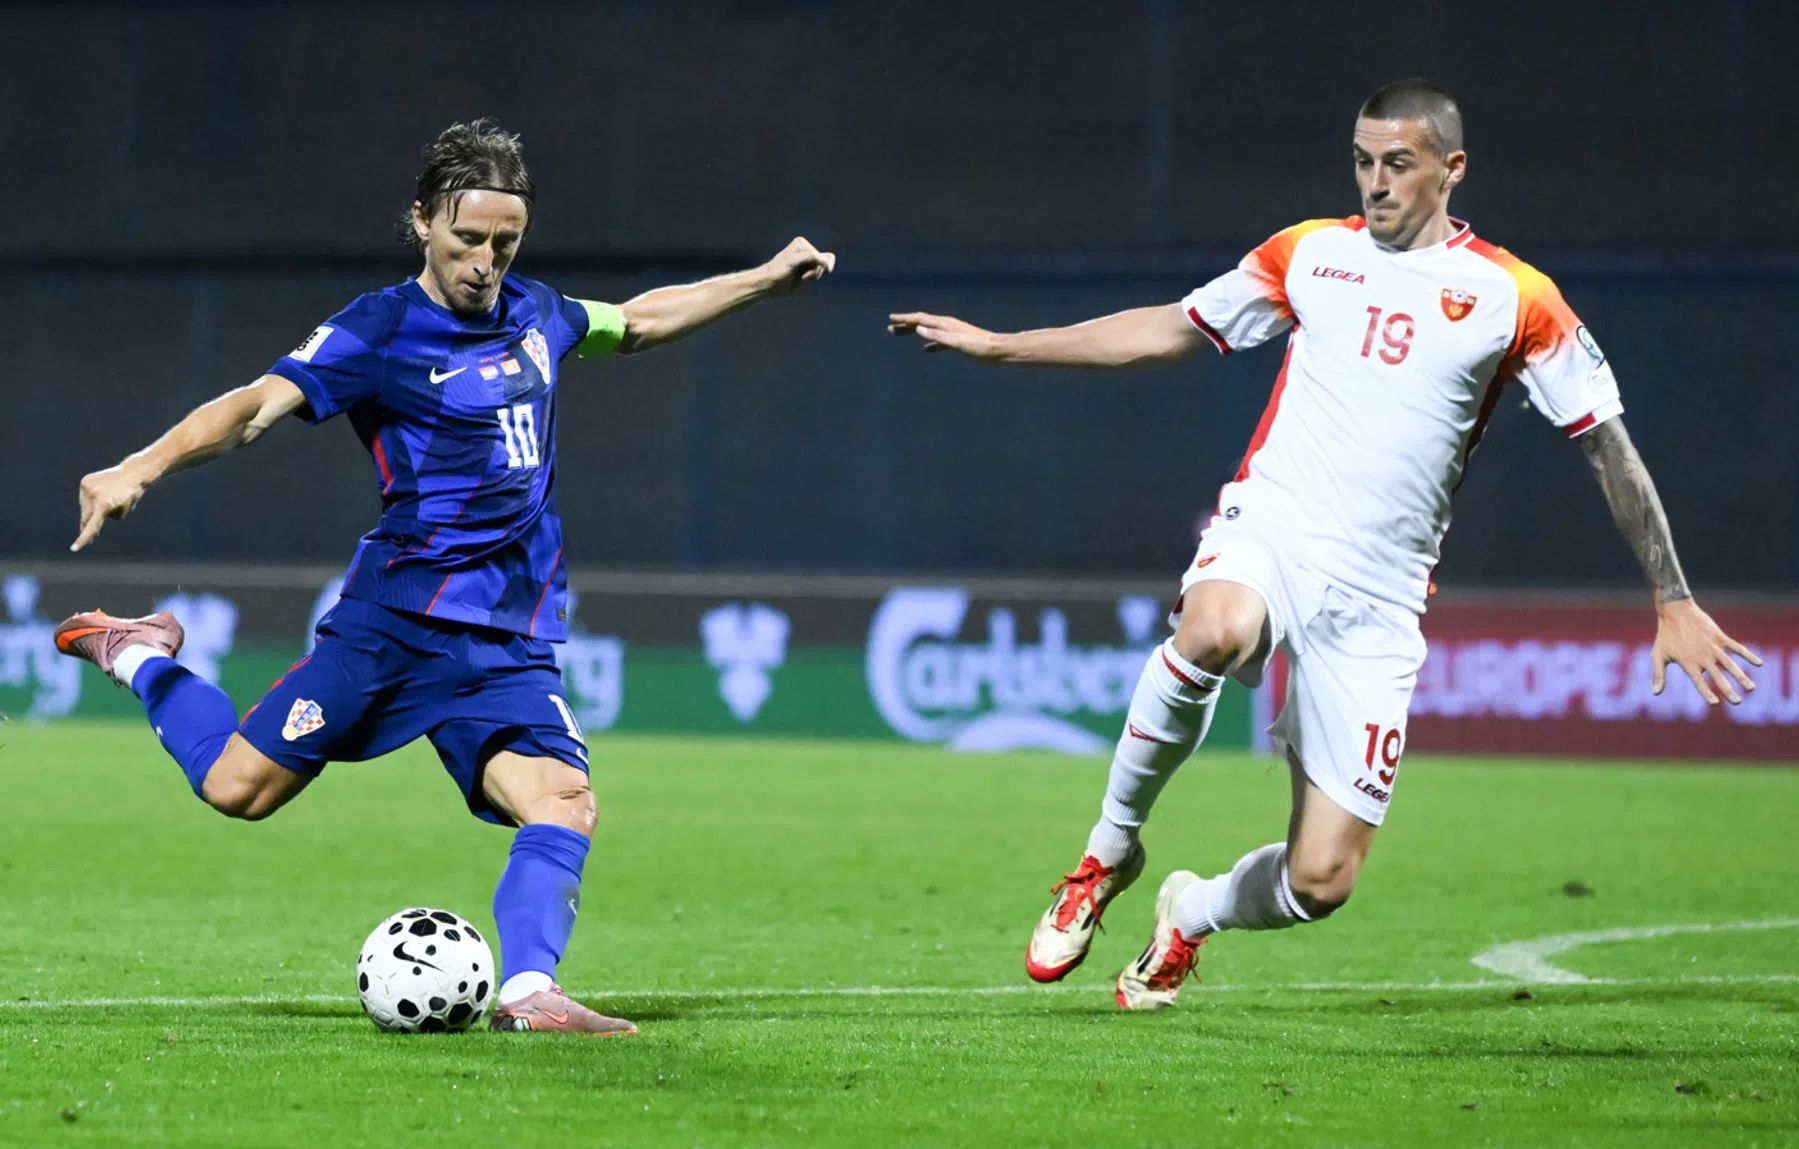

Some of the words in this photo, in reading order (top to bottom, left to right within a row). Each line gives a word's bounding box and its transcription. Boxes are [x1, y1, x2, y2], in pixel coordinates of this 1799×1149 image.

[1312, 266, 1365, 284] LEGEA
[1361, 305, 1414, 365] 19
[497, 404, 539, 469] 10
[1365, 722, 1401, 786] 19
